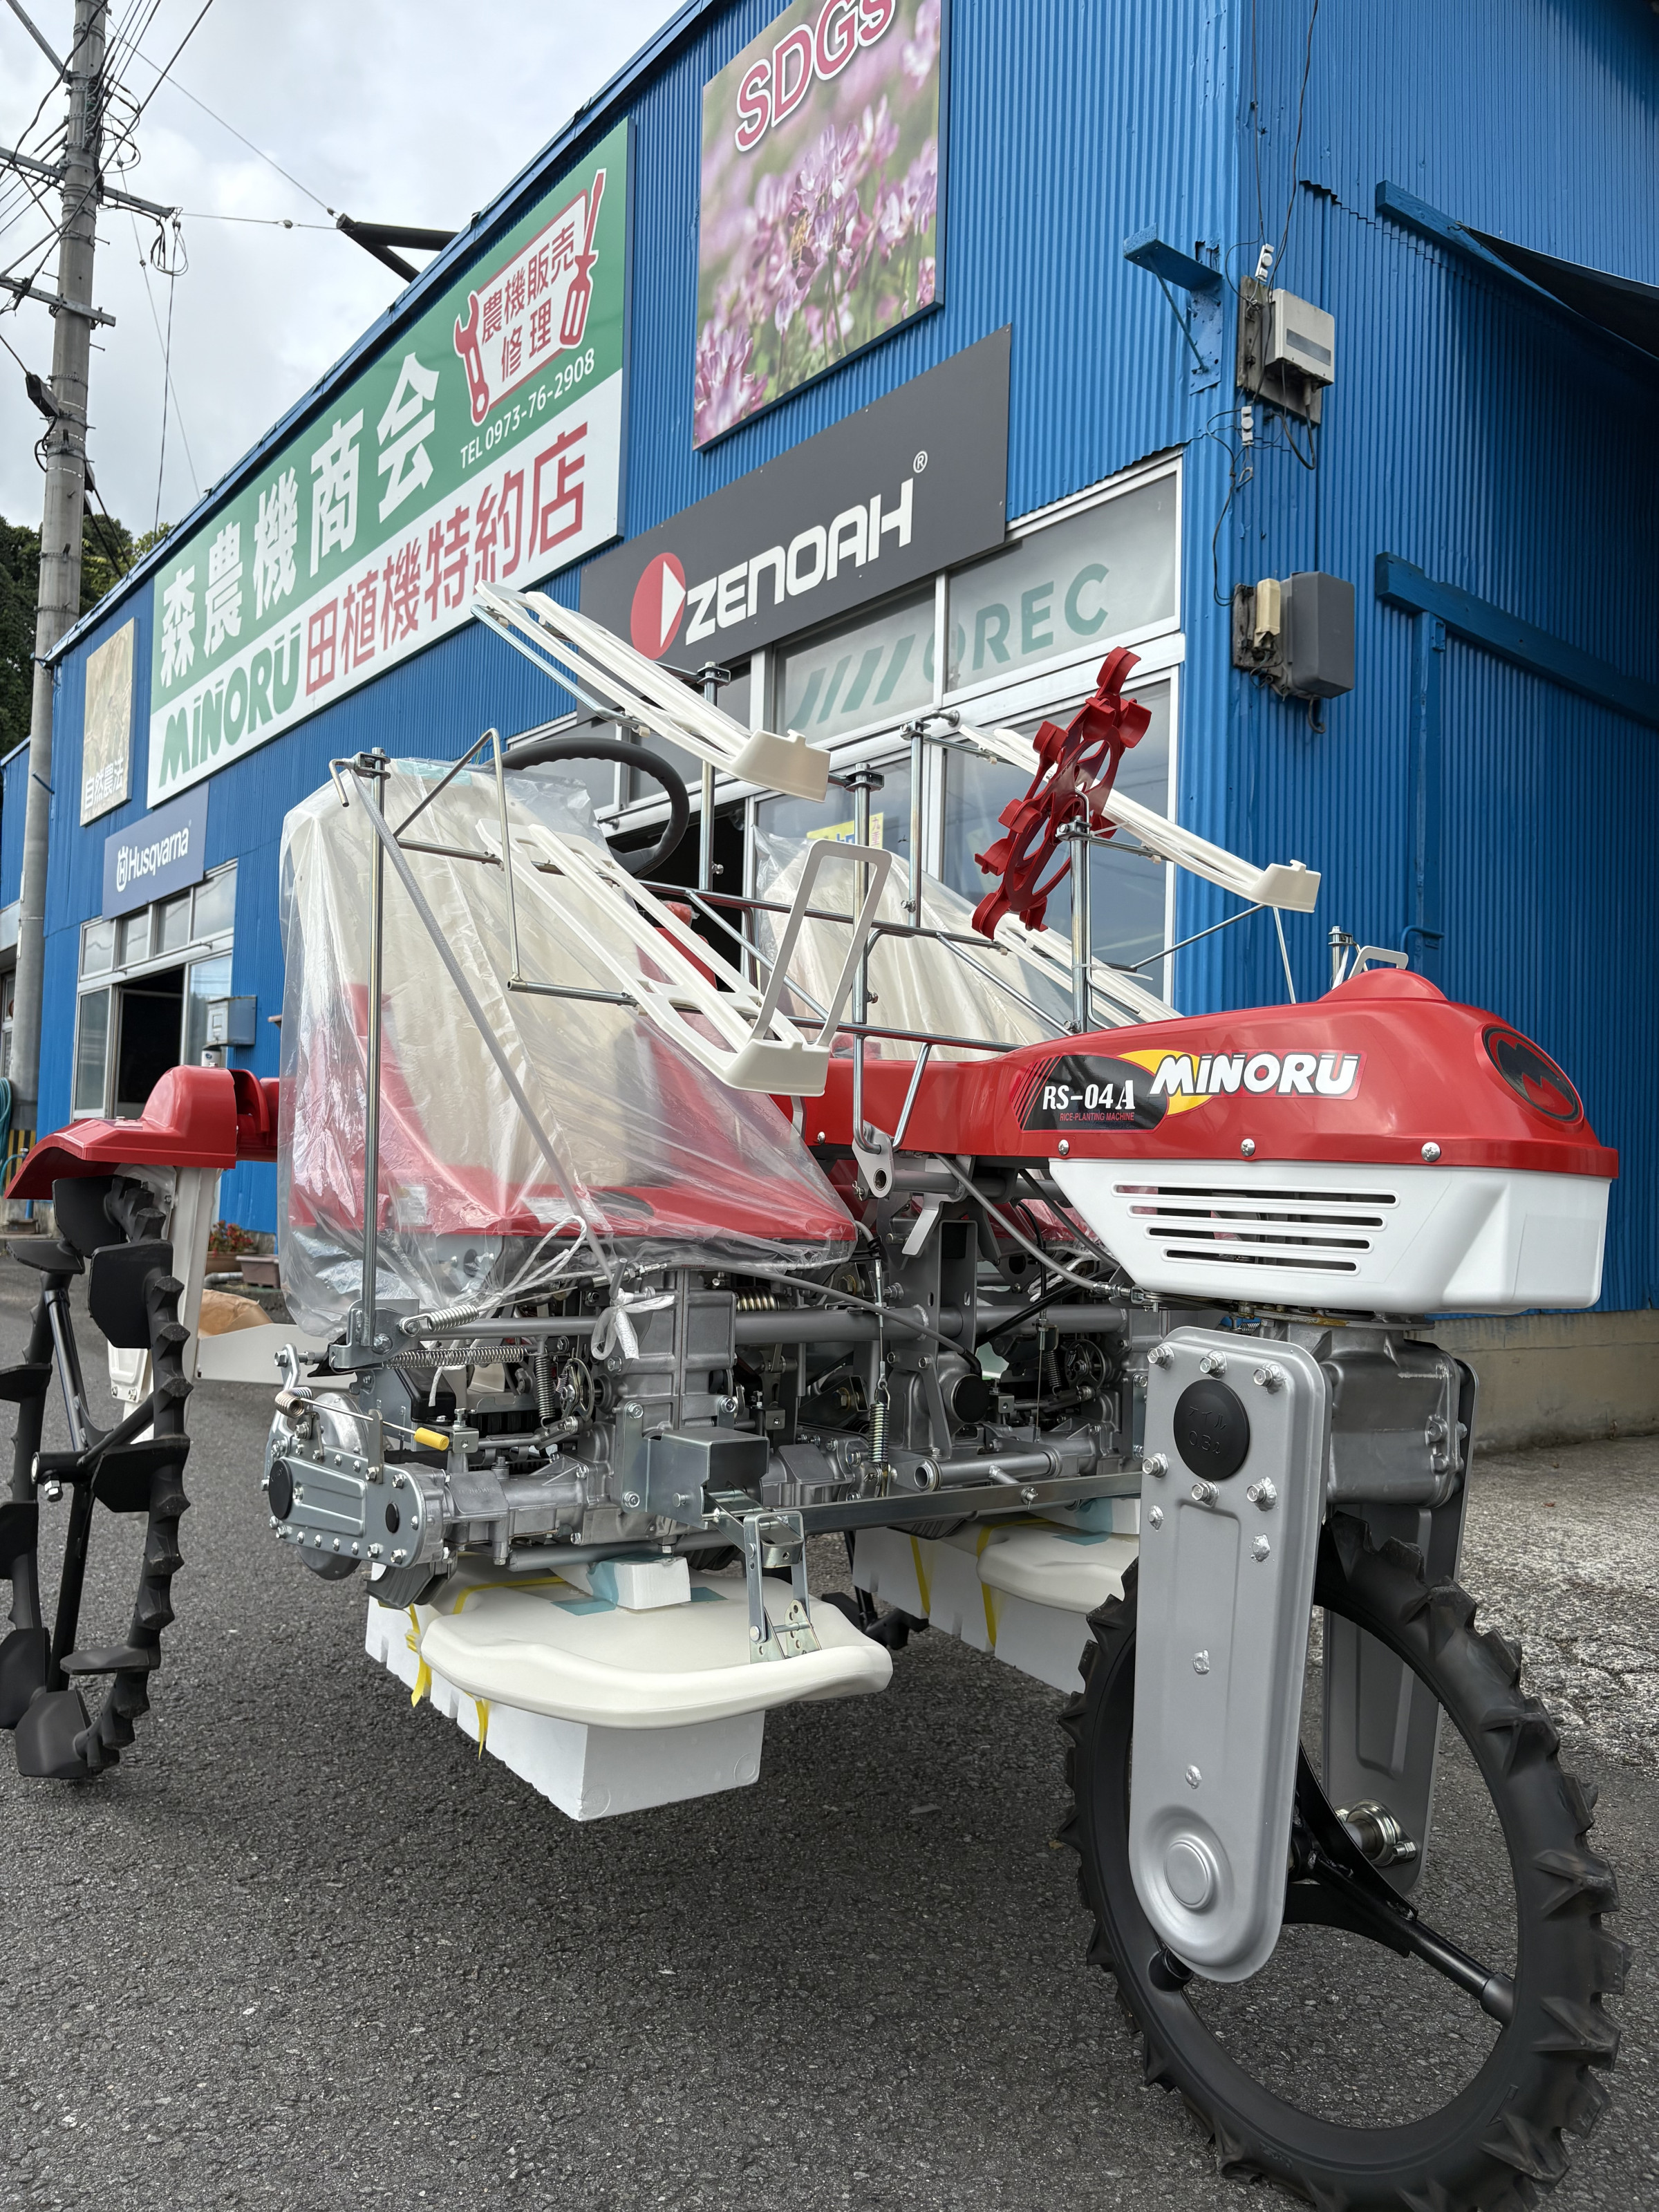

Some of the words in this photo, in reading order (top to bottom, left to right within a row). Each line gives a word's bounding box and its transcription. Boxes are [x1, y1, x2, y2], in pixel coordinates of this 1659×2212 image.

[483, 221, 575, 347] 農機販売
[500, 298, 552, 383] 修理
[460, 437, 483, 469] TEL
[485, 348, 596, 451] 0973-76-2908
[160, 353, 440, 687] 森農機商会
[305, 422, 588, 696] 田植機特約店
[685, 477, 914, 646] ZENOAH
[84, 757, 124, 810] 自然農法
[128, 827, 189, 882] Husqvarna
[1042, 1080, 1136, 1110] RS-04A
[1060, 1112, 1104, 1121] RICE-PLANTING
[1106, 1112, 1135, 1121] MACHINE
